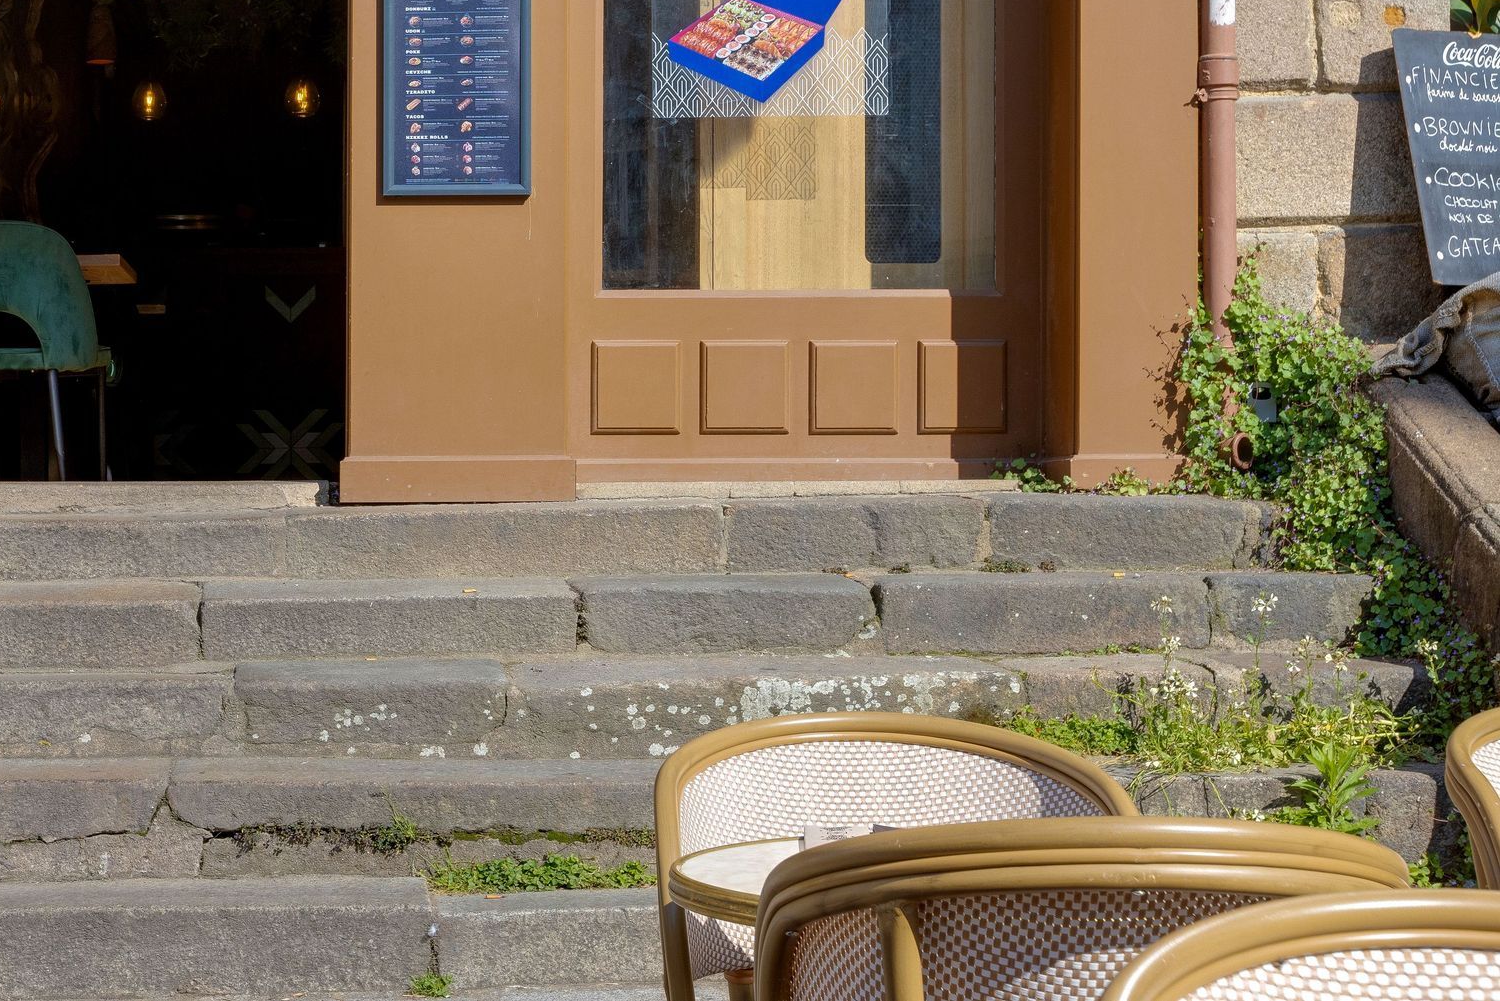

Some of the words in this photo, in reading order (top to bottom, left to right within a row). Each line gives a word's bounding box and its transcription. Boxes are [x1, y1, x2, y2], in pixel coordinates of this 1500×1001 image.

[1426, 82, 1455, 102] farine
[1459, 87, 1469, 100] de
[1476, 141, 1498, 153] noir
[1444, 194, 1498, 209] CHOCOLAT
[1449, 212, 1473, 223] NOIX
[1477, 213, 1494, 223] DE
